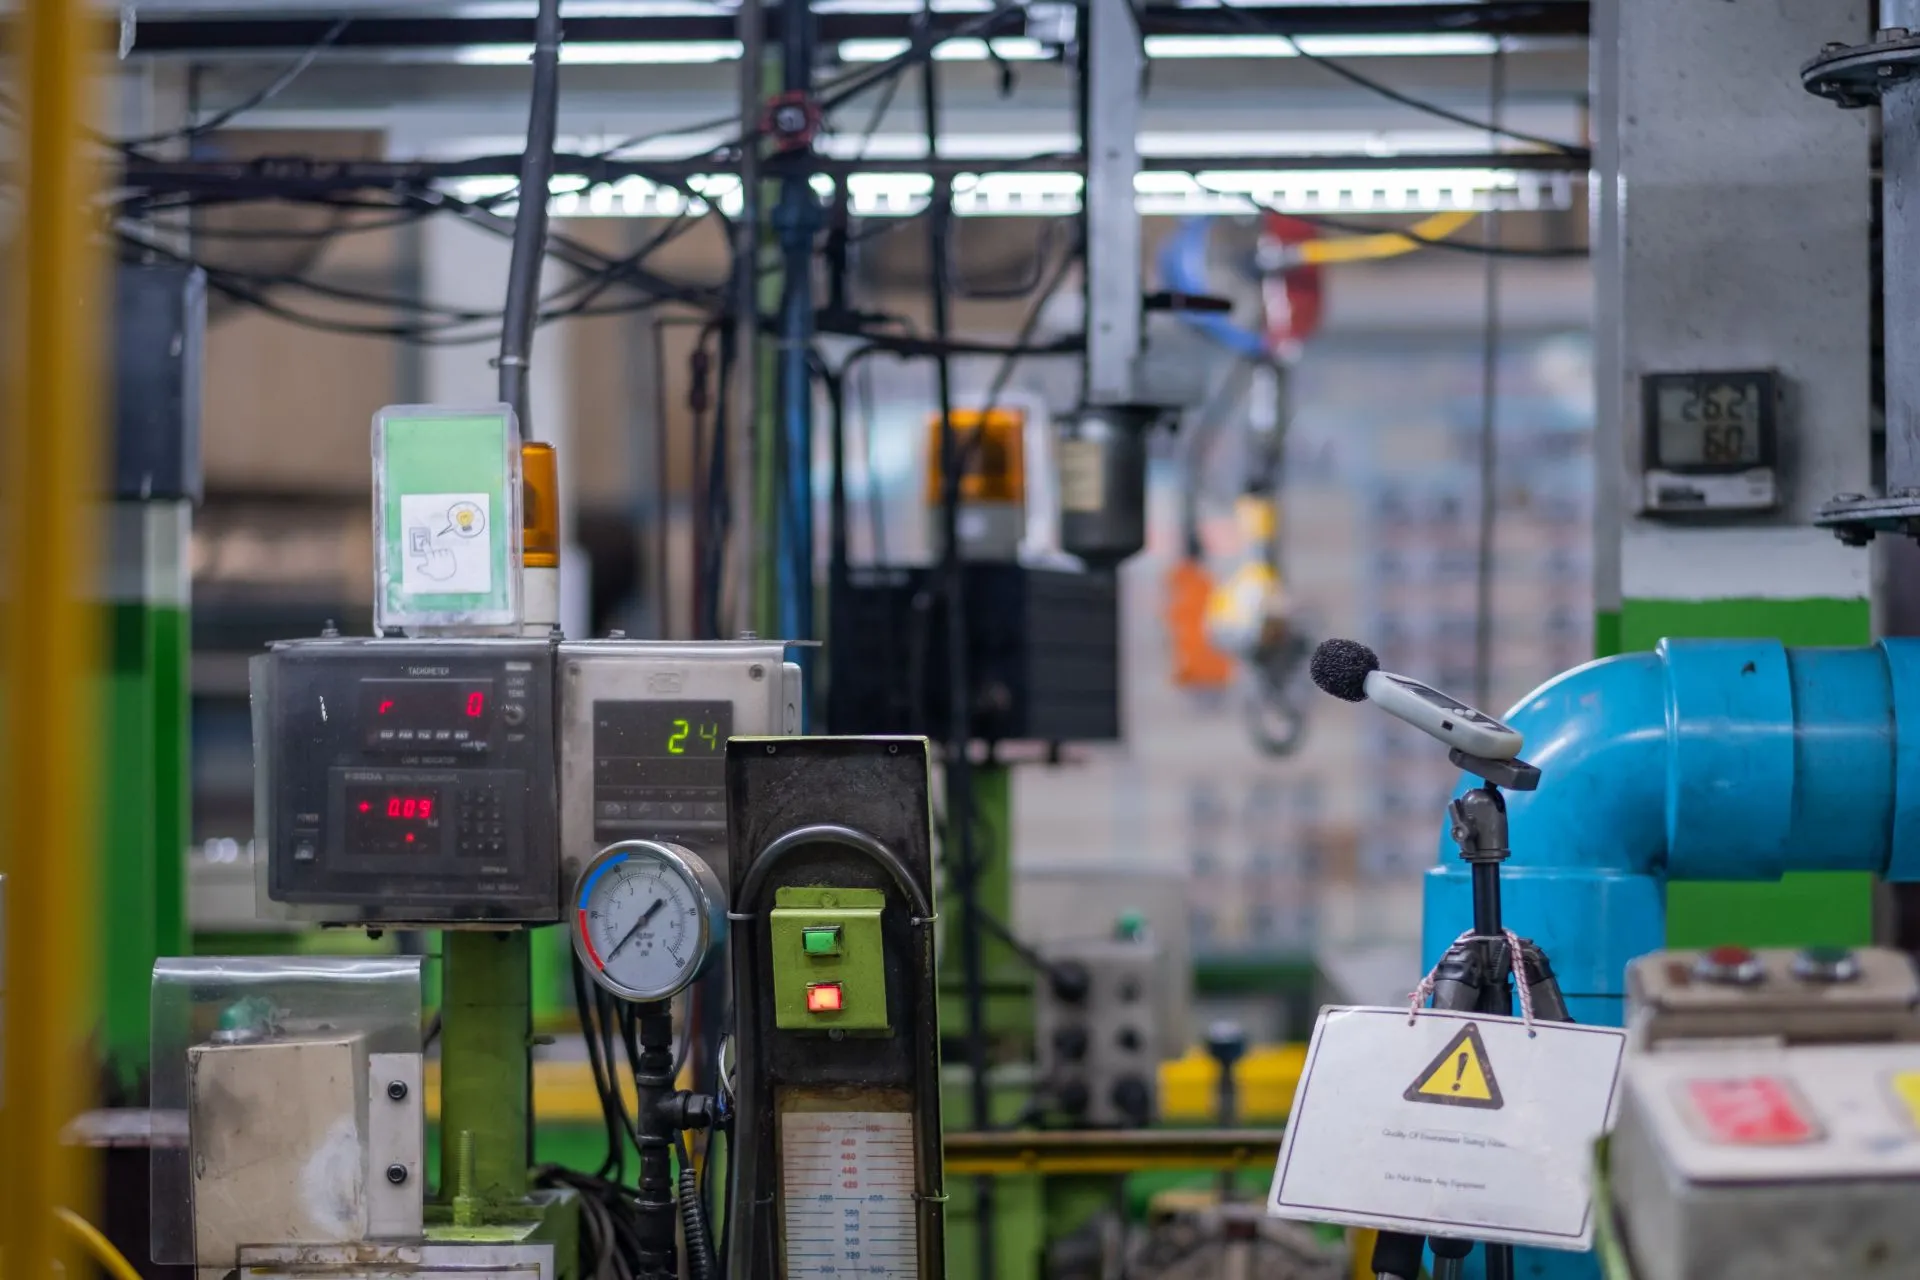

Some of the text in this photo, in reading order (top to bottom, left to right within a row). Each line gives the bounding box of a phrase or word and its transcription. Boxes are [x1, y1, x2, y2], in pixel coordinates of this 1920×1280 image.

[1703, 424, 1744, 462] 60
[465, 690, 485, 717] 0
[667, 719, 719, 754] 24
[841, 1166, 857, 1175] 440
[842, 1180, 858, 1189] 420
